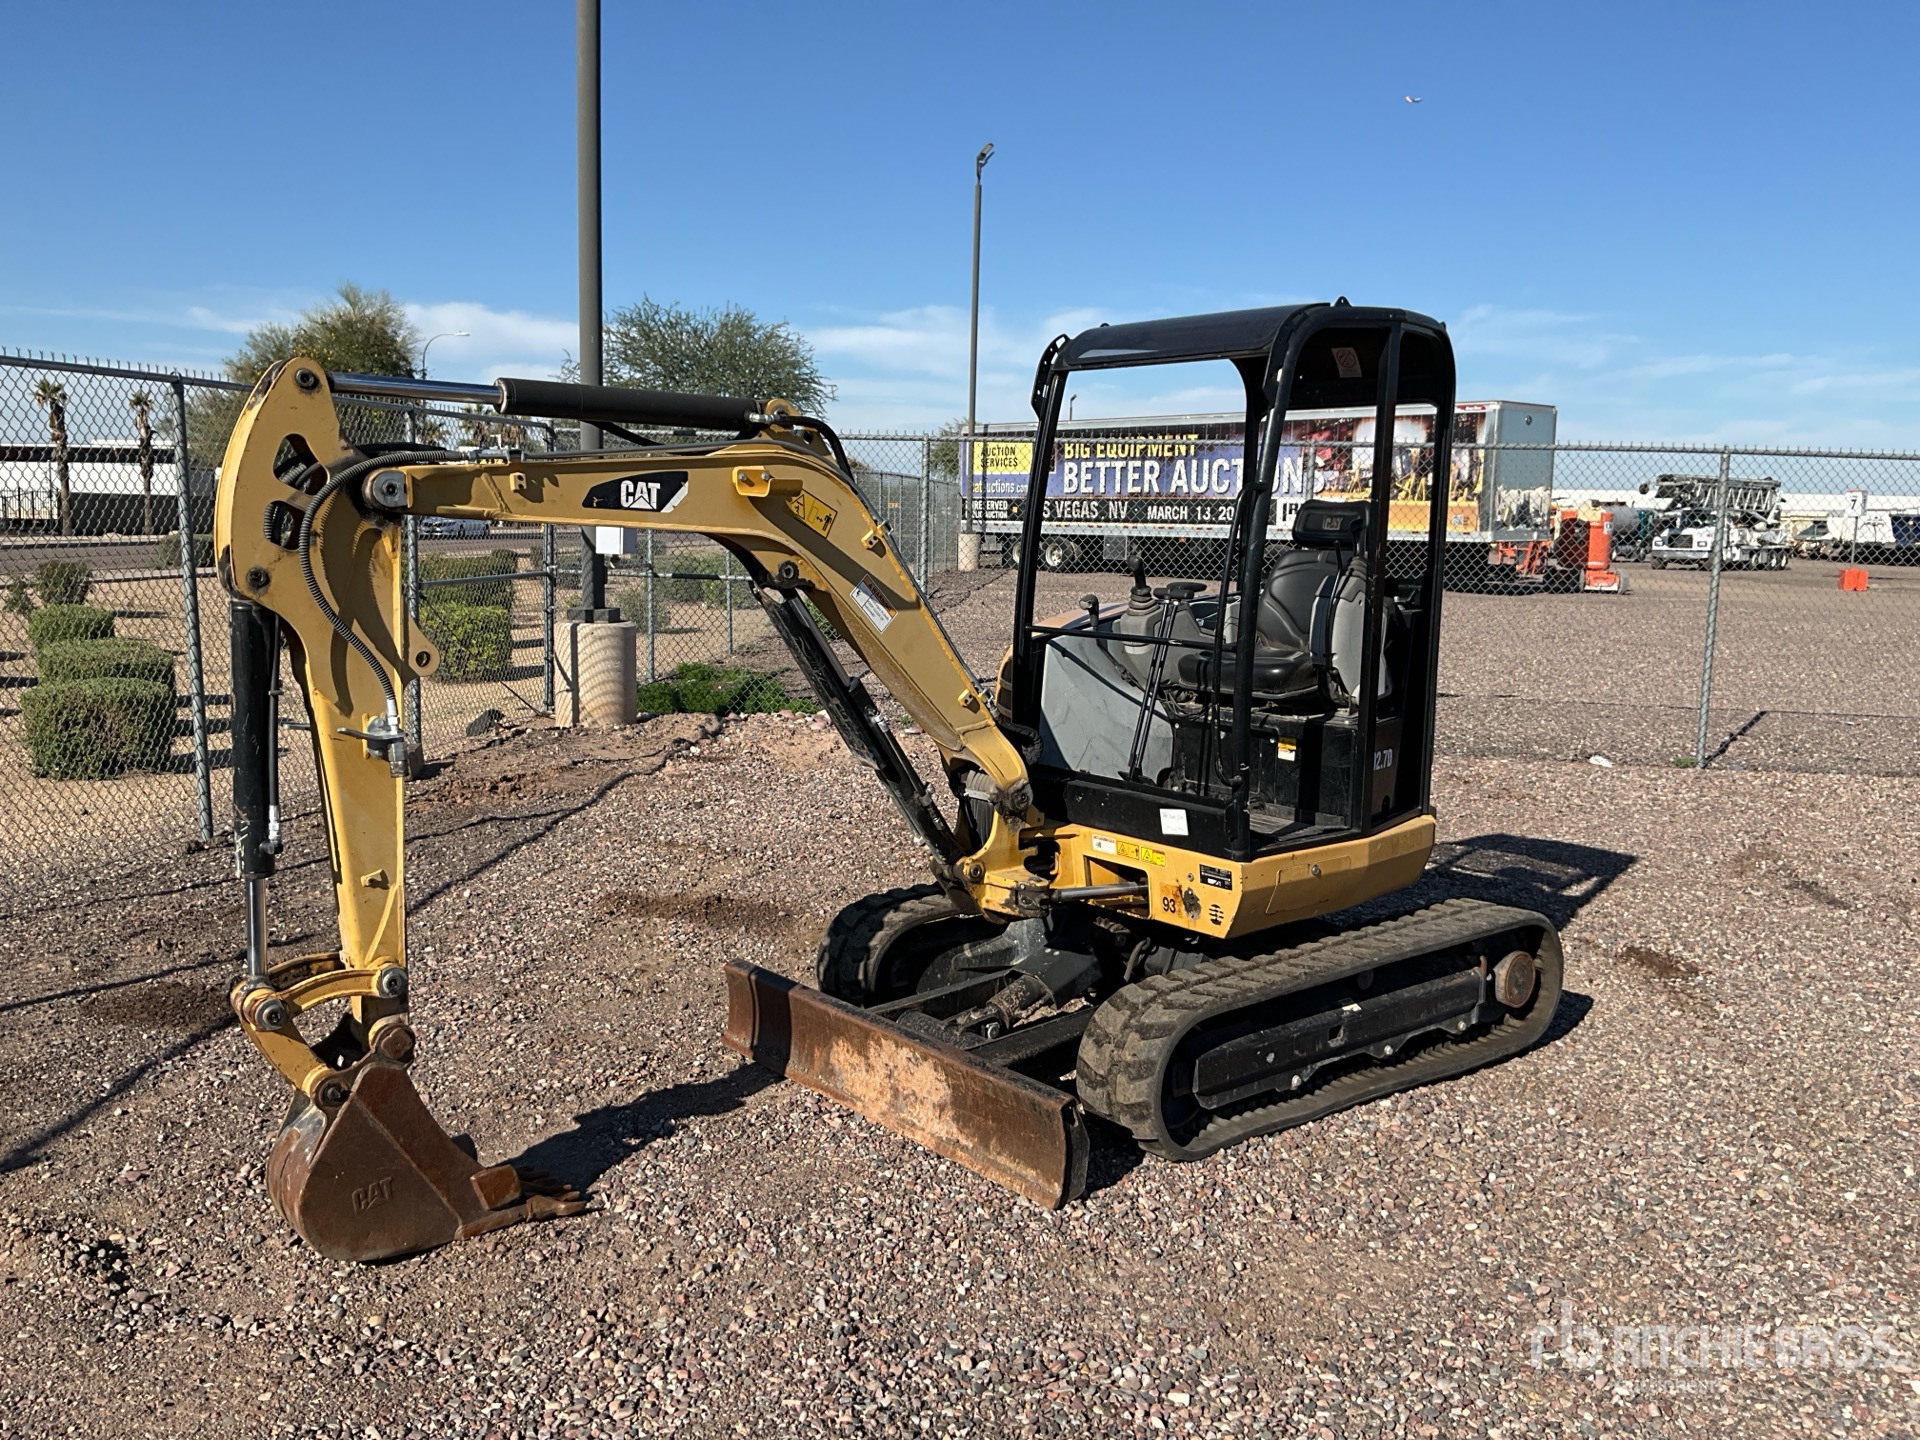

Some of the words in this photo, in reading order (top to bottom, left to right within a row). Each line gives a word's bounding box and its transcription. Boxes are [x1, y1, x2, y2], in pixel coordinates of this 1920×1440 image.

[1096, 434, 1199, 459] EQUIPMENT
[980, 457, 1018, 468] SERVICES
[1063, 460, 1160, 494] BETTER
[1170, 456, 1326, 494] AUCTNS
[620, 479, 661, 510] CAT
[1108, 501, 1129, 519] NV
[1147, 505, 1188, 520] MARCH
[1162, 896, 1176, 914] 93
[352, 1176, 394, 1214] CAT
